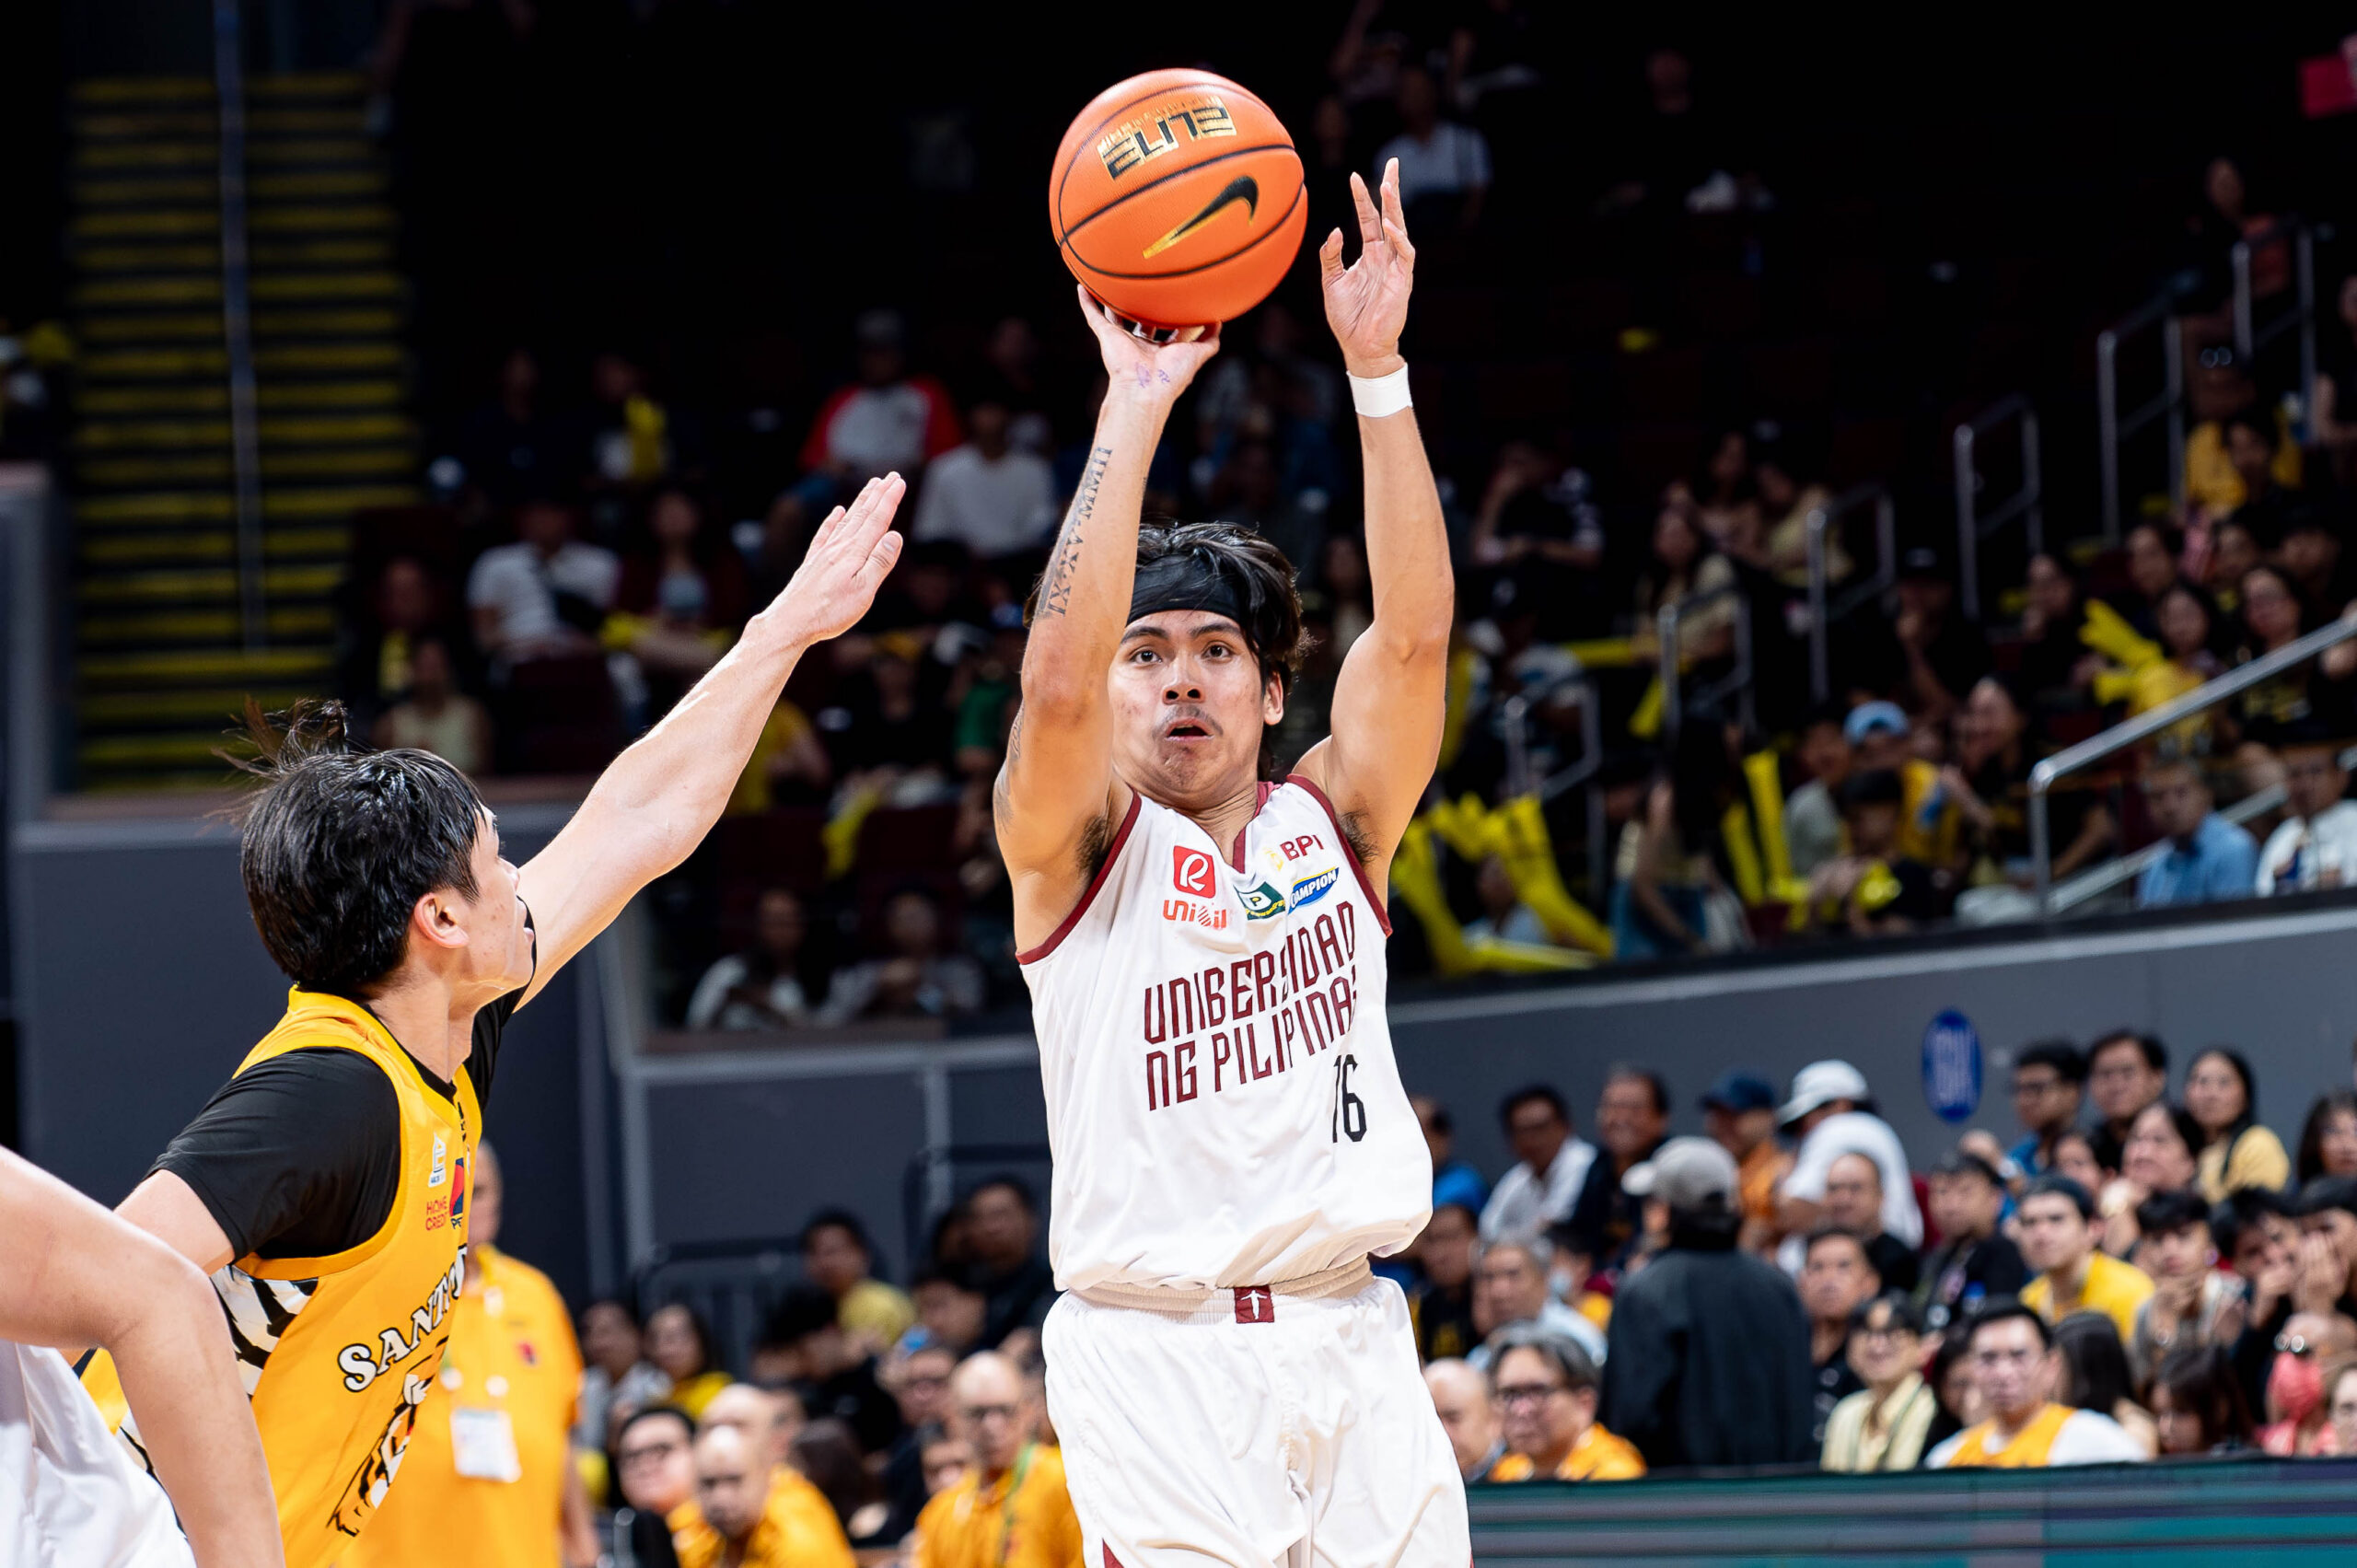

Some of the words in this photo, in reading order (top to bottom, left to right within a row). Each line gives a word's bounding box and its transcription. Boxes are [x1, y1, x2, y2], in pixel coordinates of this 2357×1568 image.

[1097, 96, 1237, 180] ELITE
[1280, 834, 1324, 861] BPI
[1145, 1040, 1197, 1111] NG
[1332, 1053, 1368, 1144] 16
